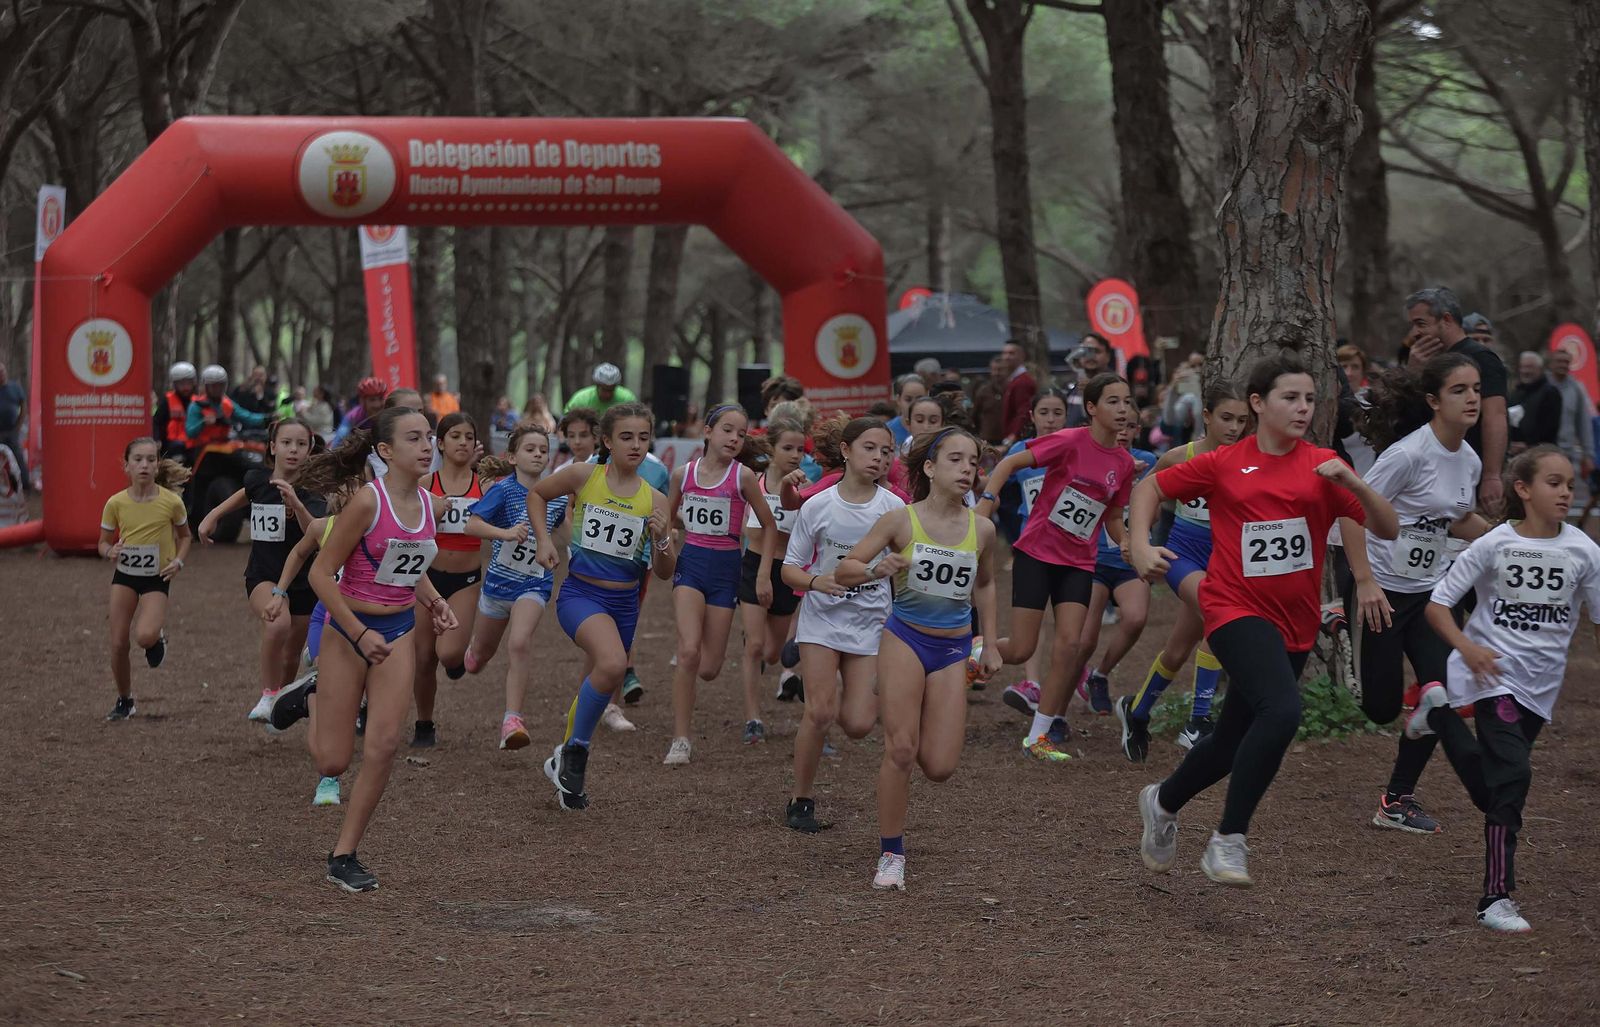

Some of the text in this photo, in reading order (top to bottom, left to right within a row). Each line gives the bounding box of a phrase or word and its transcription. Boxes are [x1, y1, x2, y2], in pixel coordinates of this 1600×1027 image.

[408, 138, 661, 171] Delegación de Deportes
[461, 174, 562, 197] Ayuntamiento
[564, 174, 583, 195] de
[585, 173, 613, 195] San
[615, 173, 661, 197] Roque
[1072, 491, 1093, 506] CROSS
[252, 514, 279, 532] 113
[594, 507, 620, 519] CROSS
[686, 506, 722, 526] 166
[1057, 500, 1096, 528] 267
[585, 518, 634, 548] 313
[1251, 523, 1284, 532] CROSS
[1249, 534, 1306, 563] 239
[1408, 533, 1432, 544] CROSS
[120, 553, 155, 568] 222
[925, 546, 956, 558] CROSS
[1407, 547, 1435, 569] 99
[1511, 550, 1543, 559] CROSS
[393, 553, 425, 575] 22
[916, 559, 971, 588] 305
[1506, 564, 1564, 591] 335
